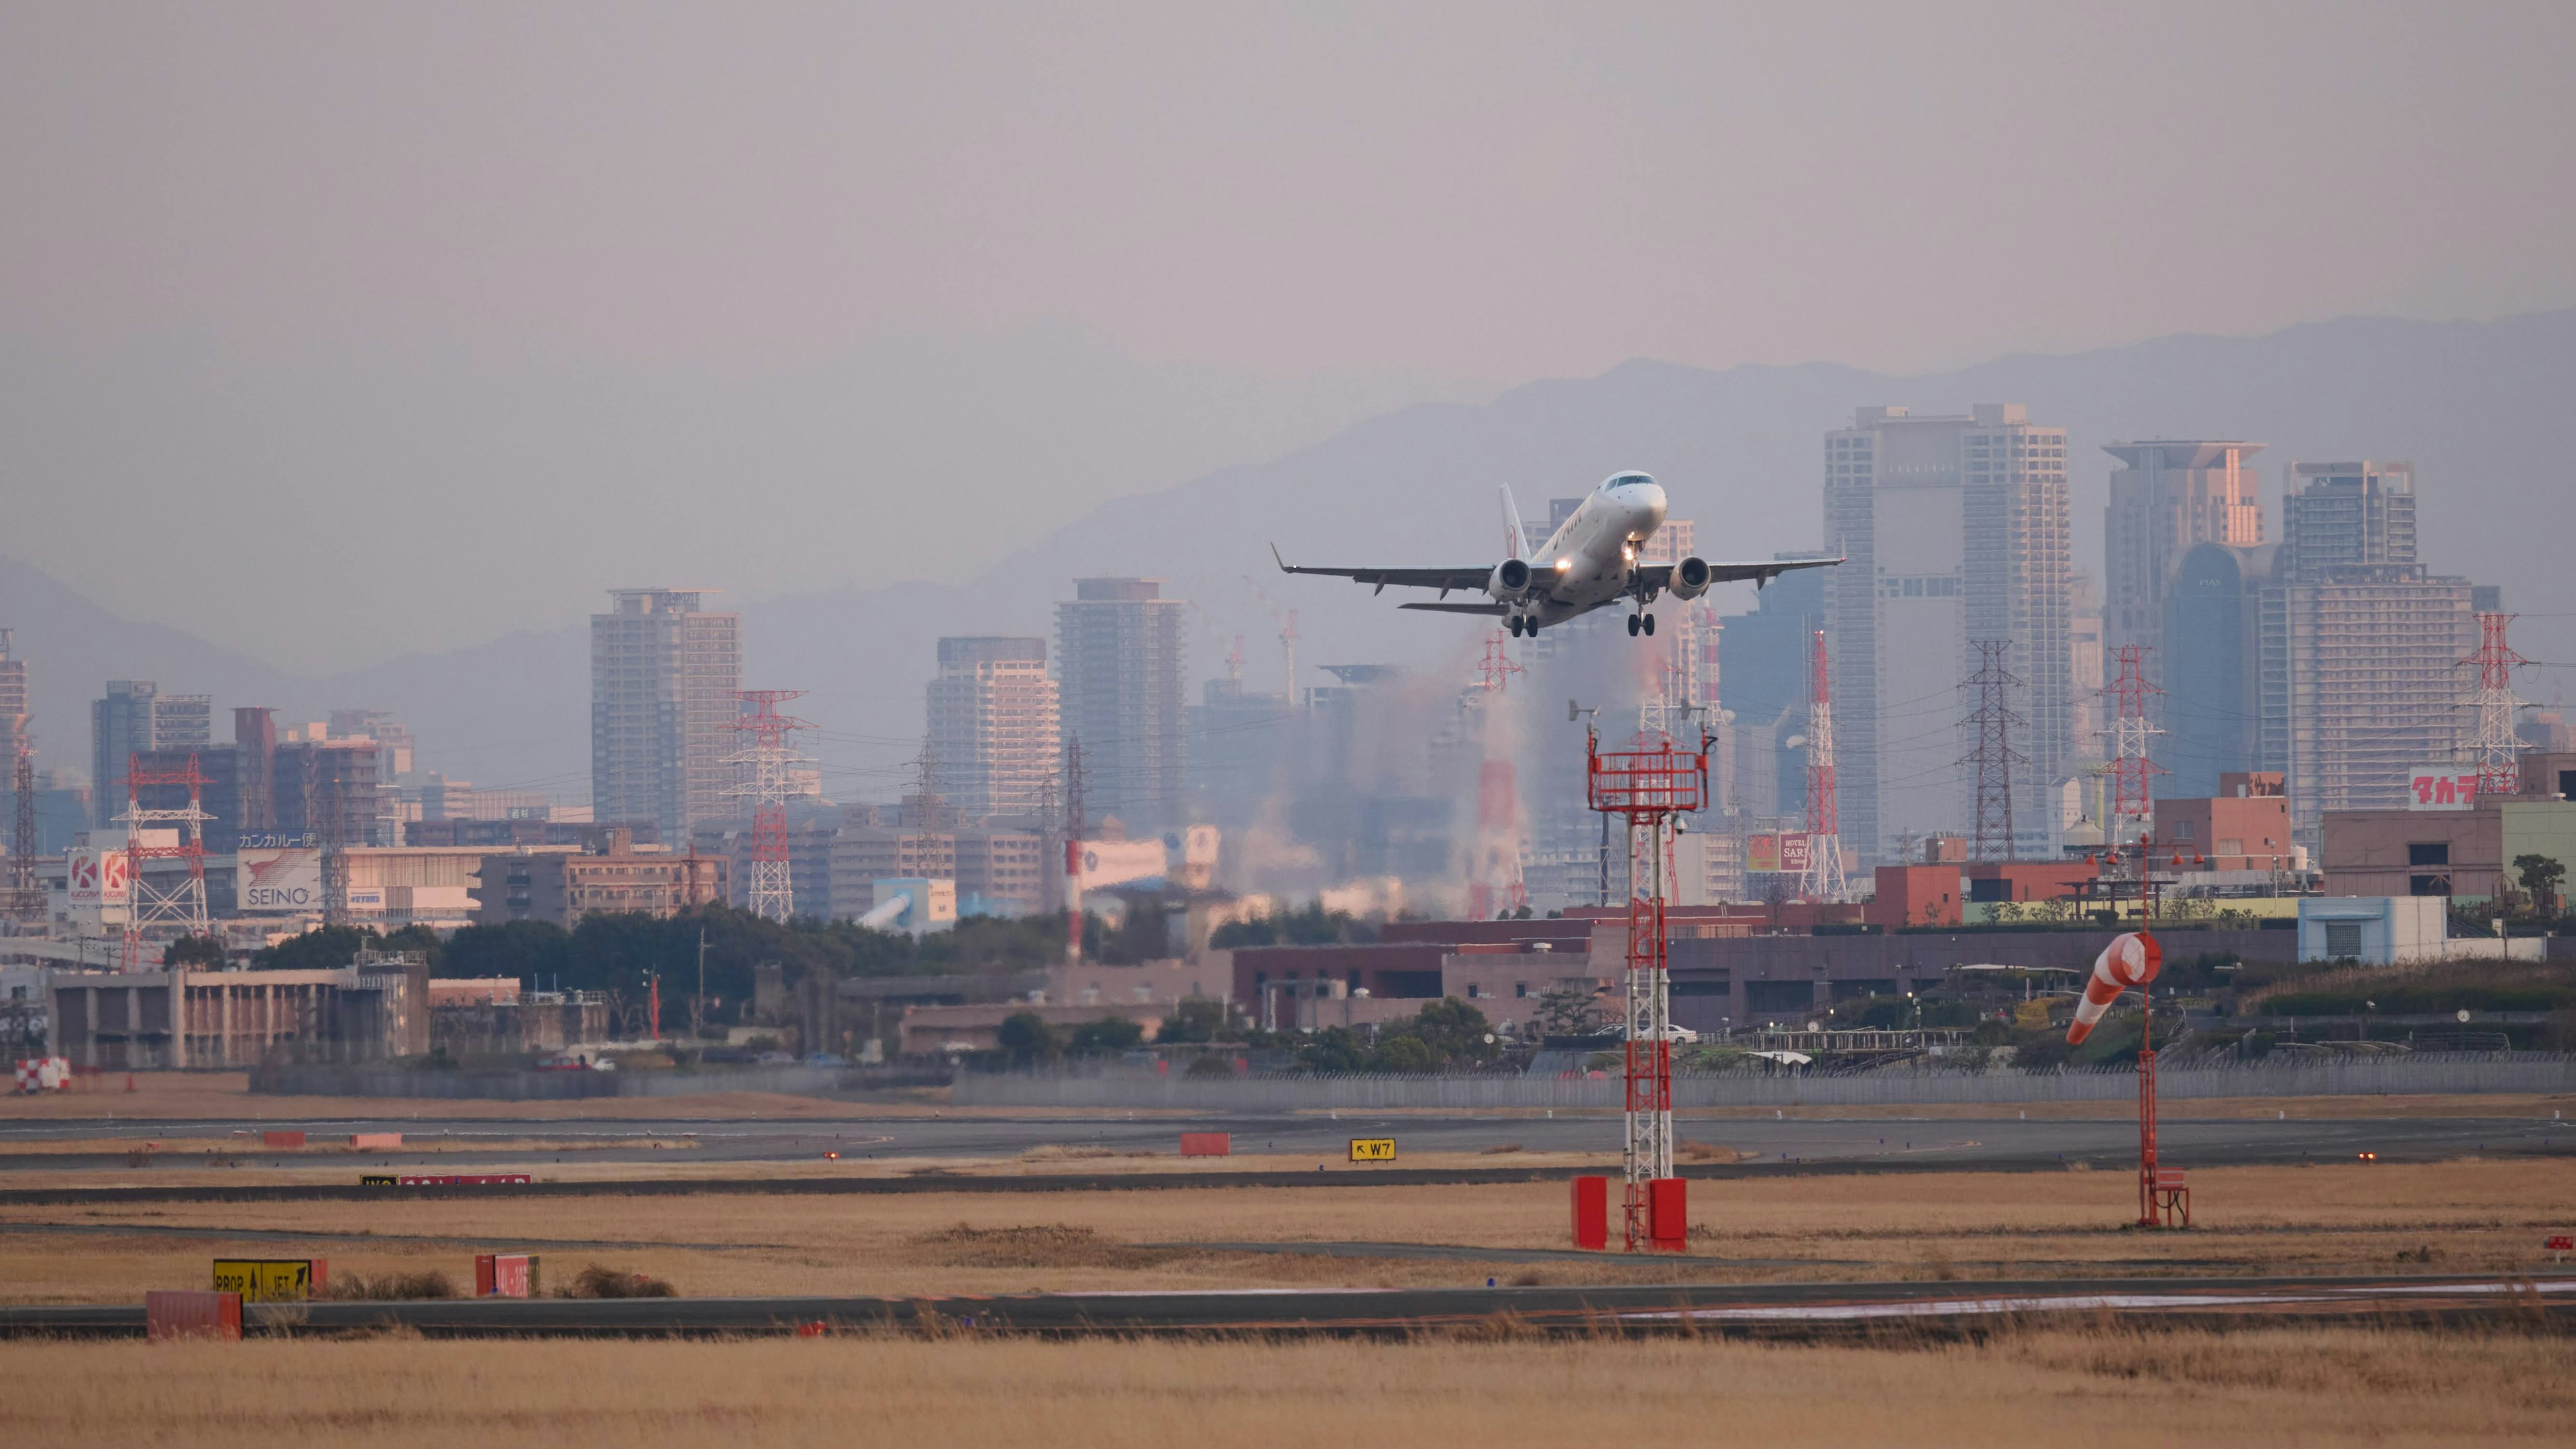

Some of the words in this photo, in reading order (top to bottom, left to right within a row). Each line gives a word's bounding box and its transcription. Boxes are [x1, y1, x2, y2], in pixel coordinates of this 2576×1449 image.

[248, 888, 309, 904] SEINO
[1370, 1143, 1390, 1156] W7
[216, 1275, 244, 1292] PROP
[272, 1276, 289, 1296] JET
